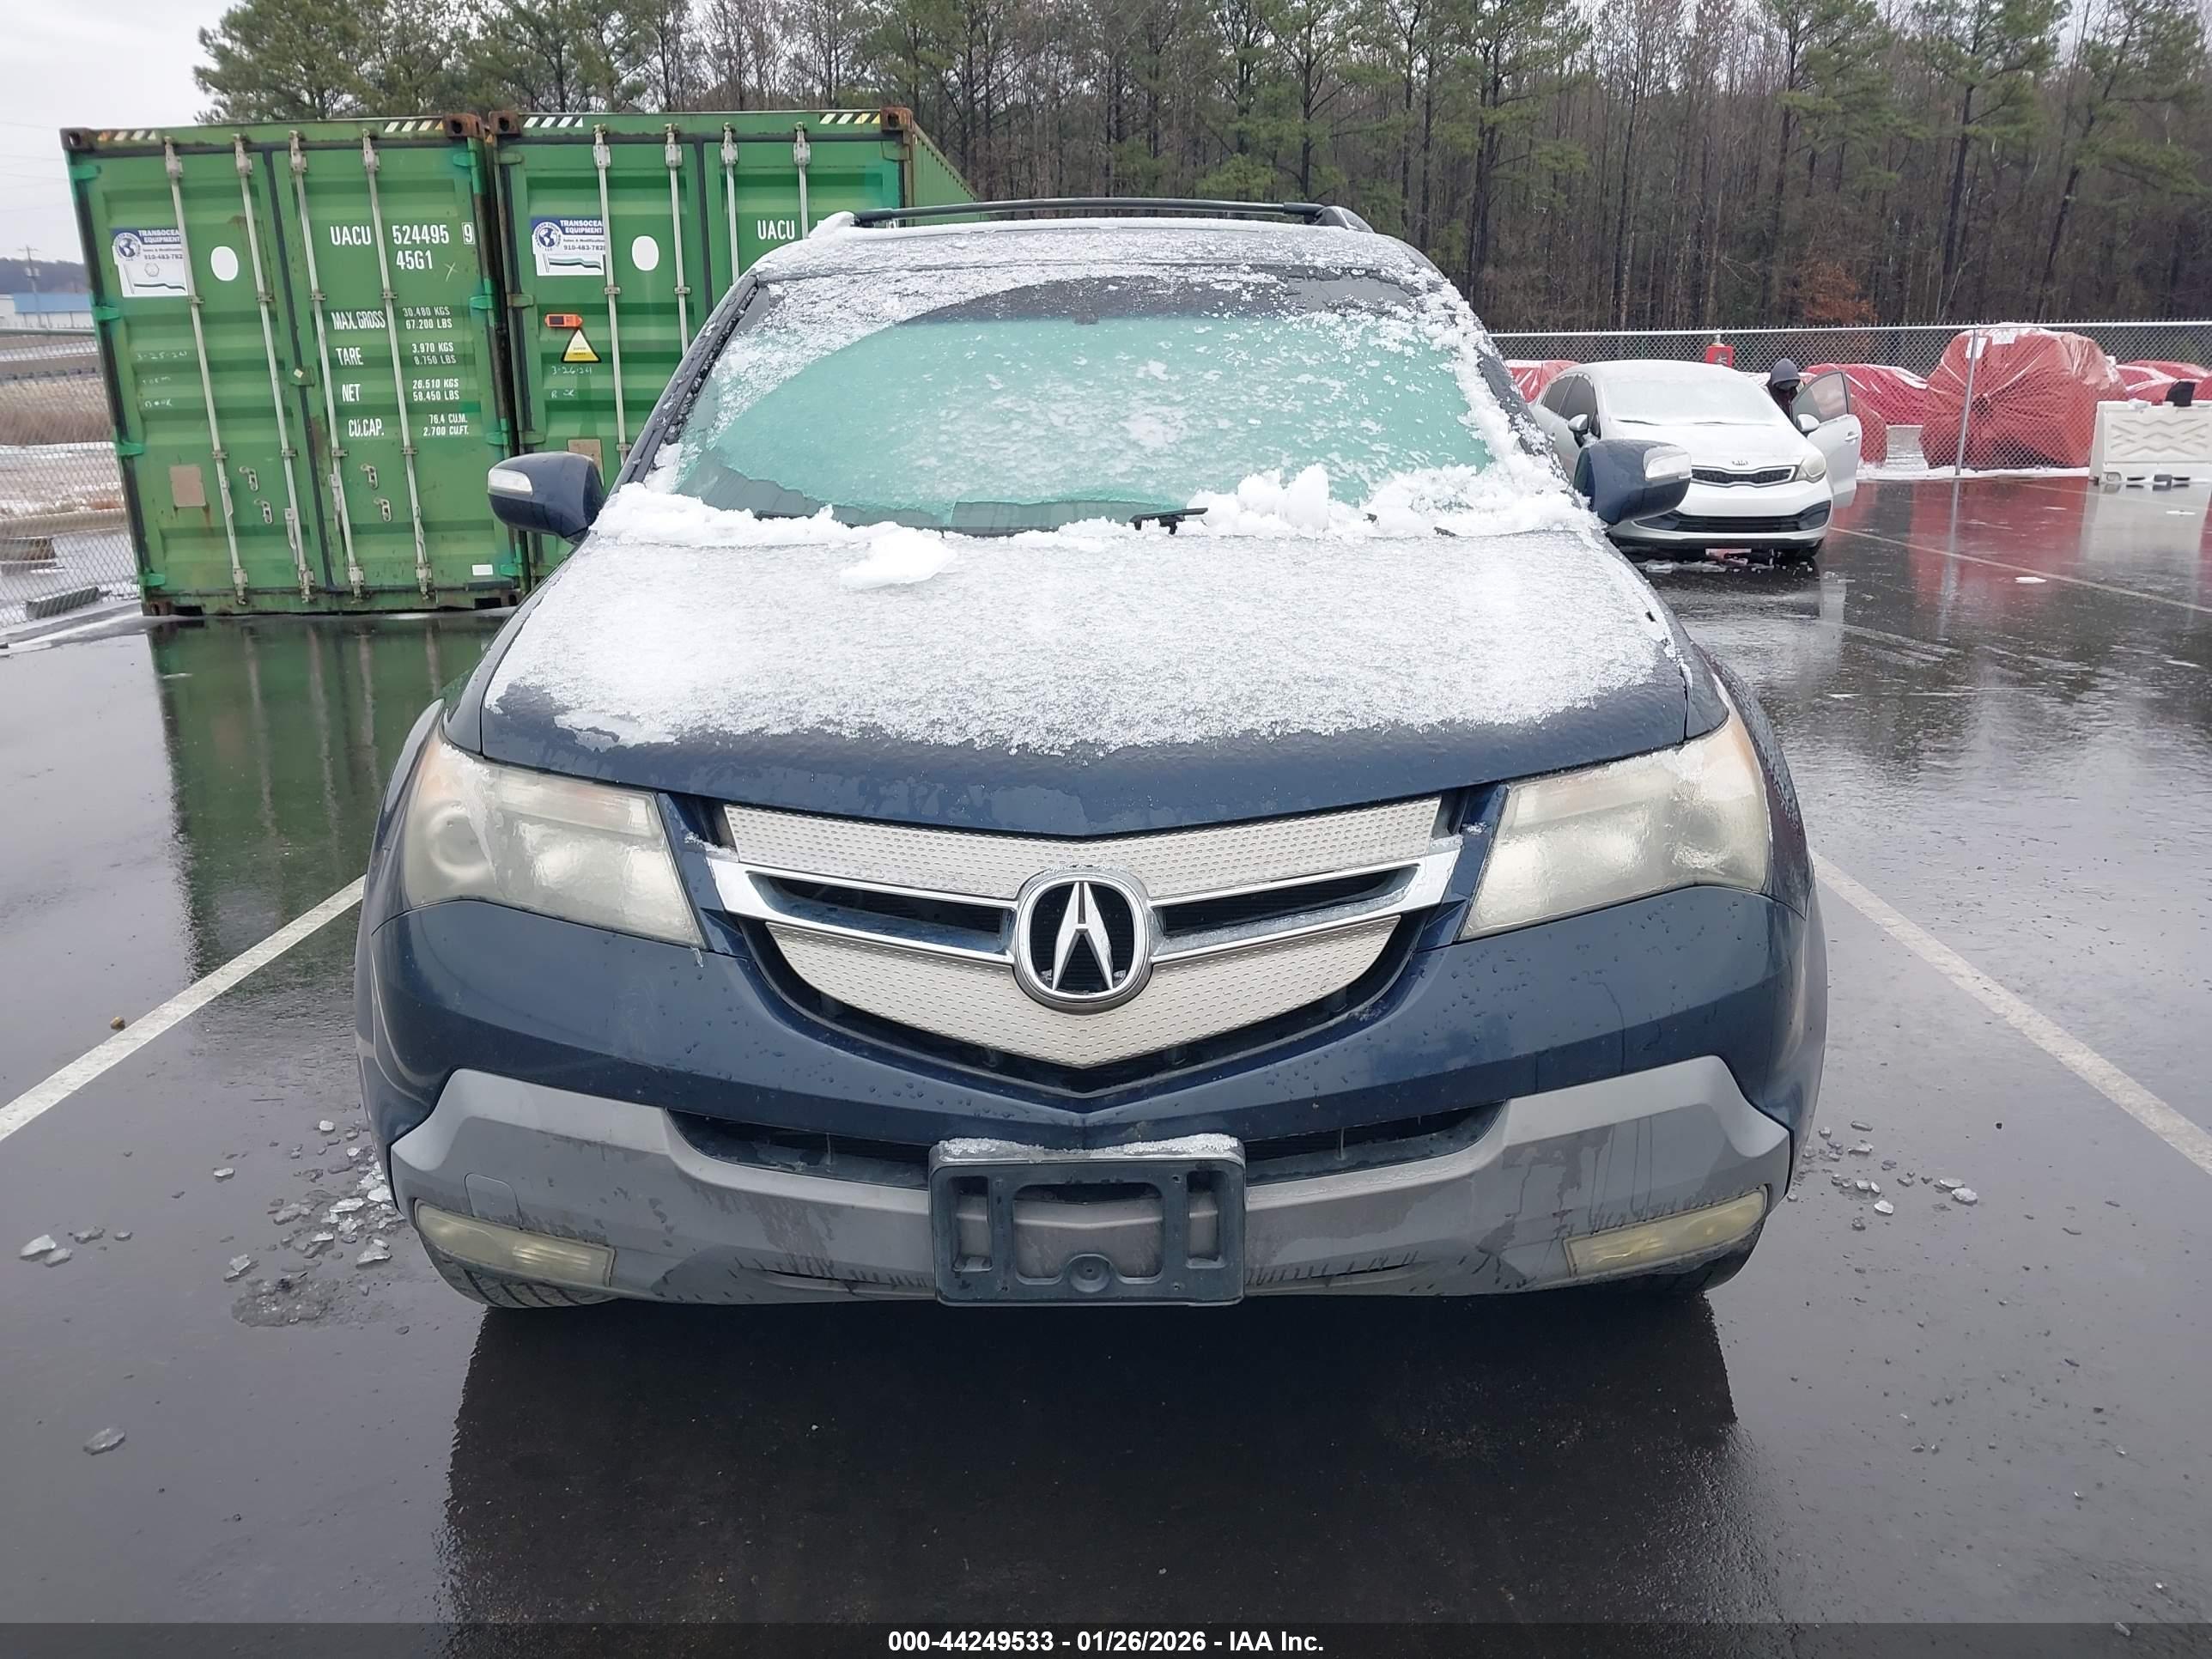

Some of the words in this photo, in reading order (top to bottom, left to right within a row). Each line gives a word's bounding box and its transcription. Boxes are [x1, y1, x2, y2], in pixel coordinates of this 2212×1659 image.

[330, 225, 372, 246] UACU
[392, 224, 450, 245] 524495
[463, 223, 474, 244] 9
[757, 220, 795, 240] UACU
[396, 250, 433, 270] 45G1
[403, 307, 431, 317] 30.480
[434, 306, 451, 316] KGS
[405, 319, 434, 330] 67.200
[436, 318, 453, 329] LBS
[412, 343, 435, 353] 3.970
[438, 342, 454, 352] KGS
[336, 347, 364, 366] TARE
[414, 355, 438, 365] 8.750
[440, 354, 457, 364] LBS
[412, 379, 441, 389] 26.510
[443, 378, 459, 388] KGS
[342, 383, 361, 402] NET
[412, 391, 441, 402] 58.450
[444, 390, 460, 401] LBS
[428, 414, 446, 424] 76.4
[348, 418, 385, 437] CU.CAP.
[422, 426, 446, 436] 2.700
